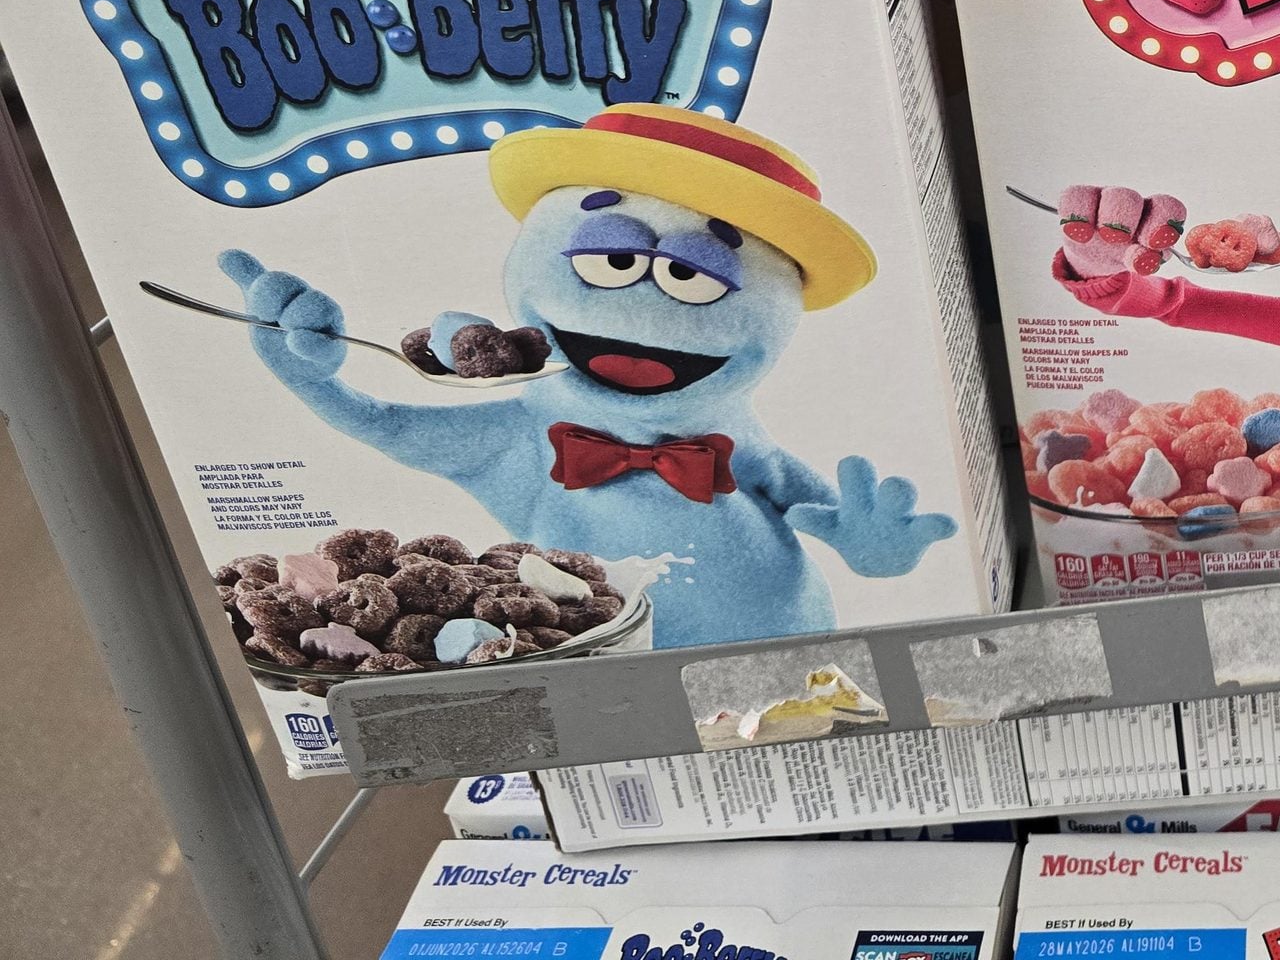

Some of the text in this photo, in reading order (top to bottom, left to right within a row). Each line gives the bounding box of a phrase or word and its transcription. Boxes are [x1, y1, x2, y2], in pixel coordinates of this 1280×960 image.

[194, 460, 307, 473] ENLARGED TO SHOW DETAIL
[199, 472, 264, 482] AMPLIADA PARA
[201, 480, 284, 490] MOSTRAR DETALLES
[1057, 555, 1085, 573] 160
[289, 716, 320, 733] 160
[1040, 850, 1242, 877] Monster Cereals
[433, 863, 631, 887] Monster Cereals
[1046, 918, 1133, 930] BEST If Used By
[408, 942, 476, 956] 01JUN2026
[1038, 936, 1175, 957] 28MAY2026 AL191104
